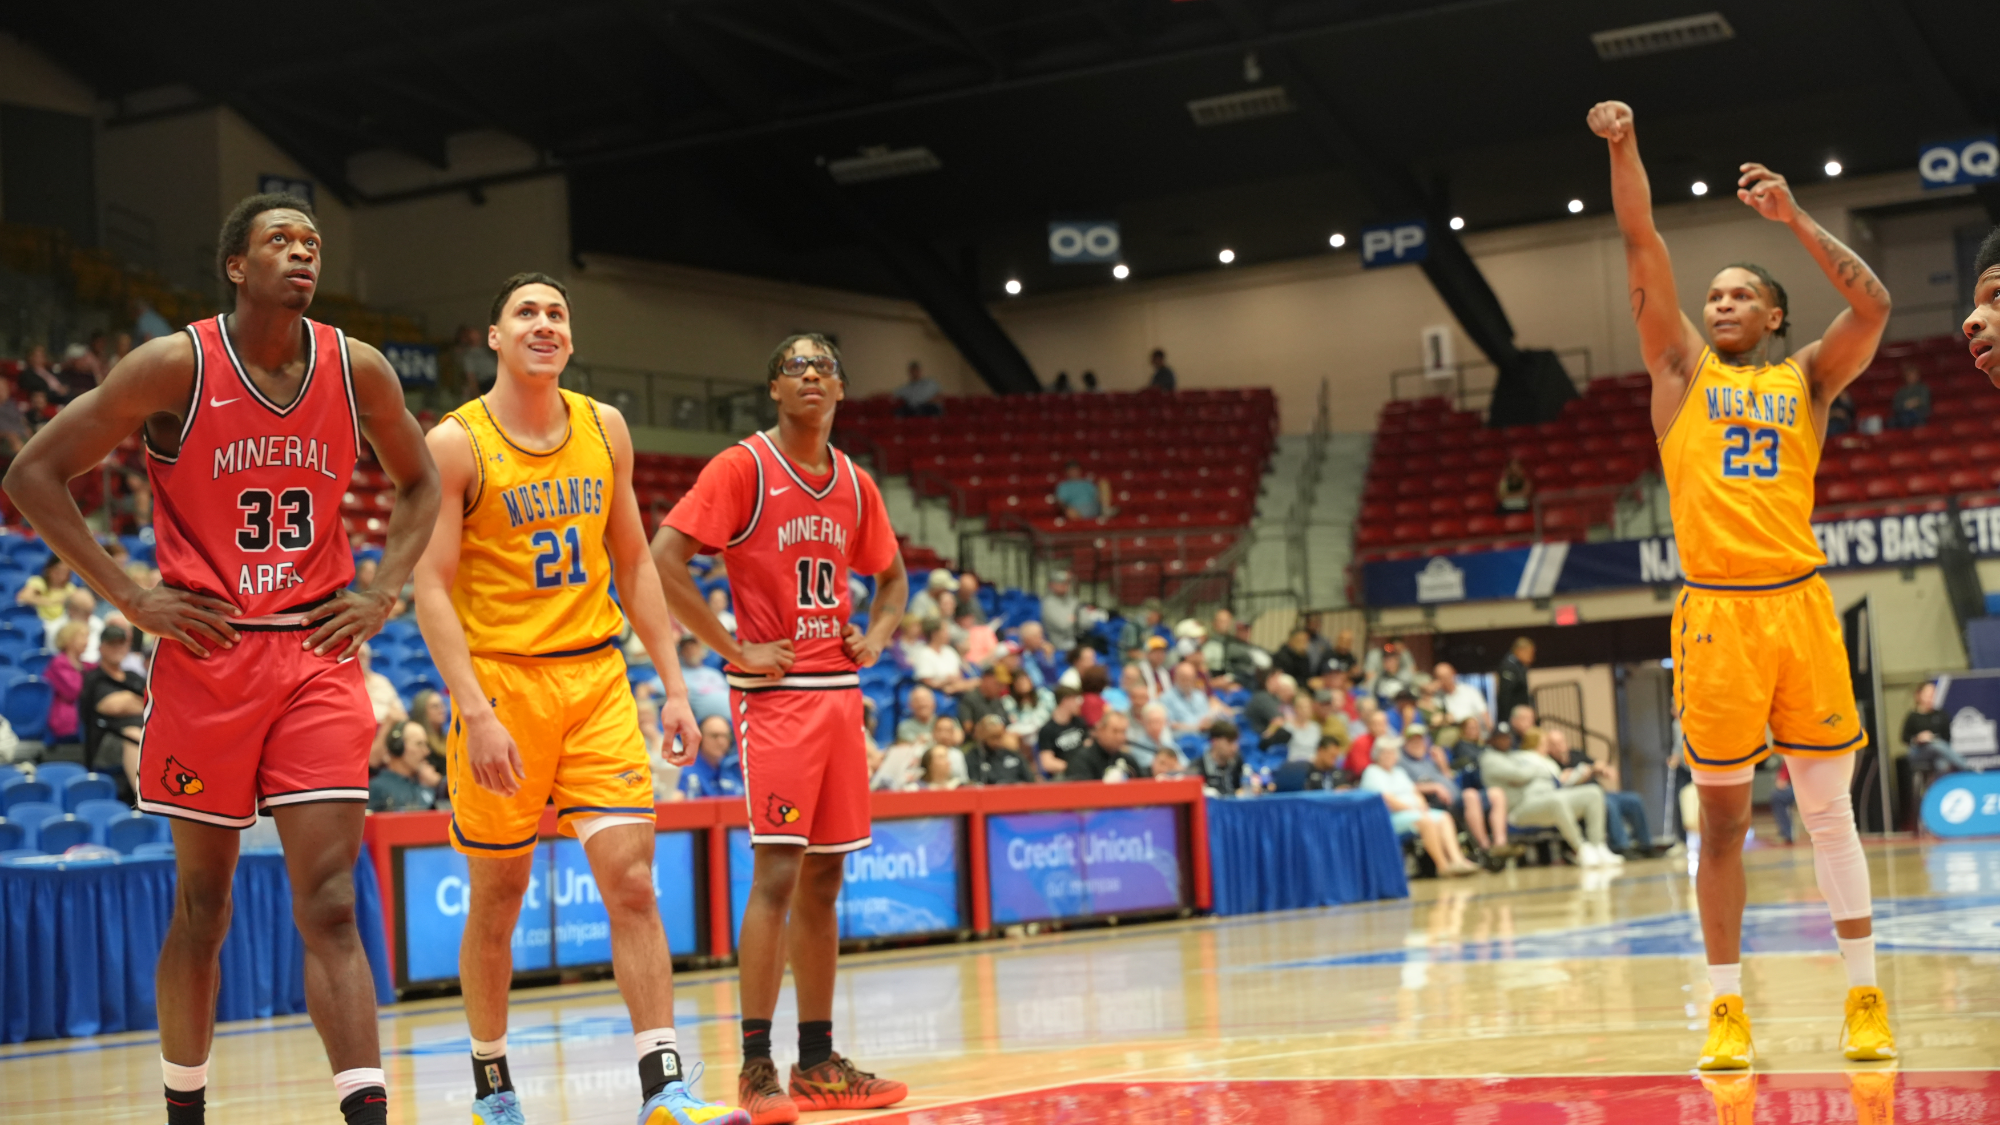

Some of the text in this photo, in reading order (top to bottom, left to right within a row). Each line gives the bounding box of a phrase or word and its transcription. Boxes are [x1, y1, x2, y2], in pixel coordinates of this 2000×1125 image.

[1919, 141, 1999, 182] QQ
[1048, 226, 1120, 257] OO
[1363, 225, 1425, 261] PP
[212, 435, 337, 480] MINERAL
[1723, 425, 1780, 478] 23
[235, 487, 315, 552] 33
[502, 477, 603, 528] MUSTANGS
[531, 525, 588, 590] 21
[1809, 518, 1878, 566] EN'S
[238, 562, 304, 595] AREA
[795, 556, 840, 609] 10
[794, 614, 840, 641] AREA
[1007, 833, 1077, 871] Credit
[435, 873, 541, 917] Crt
